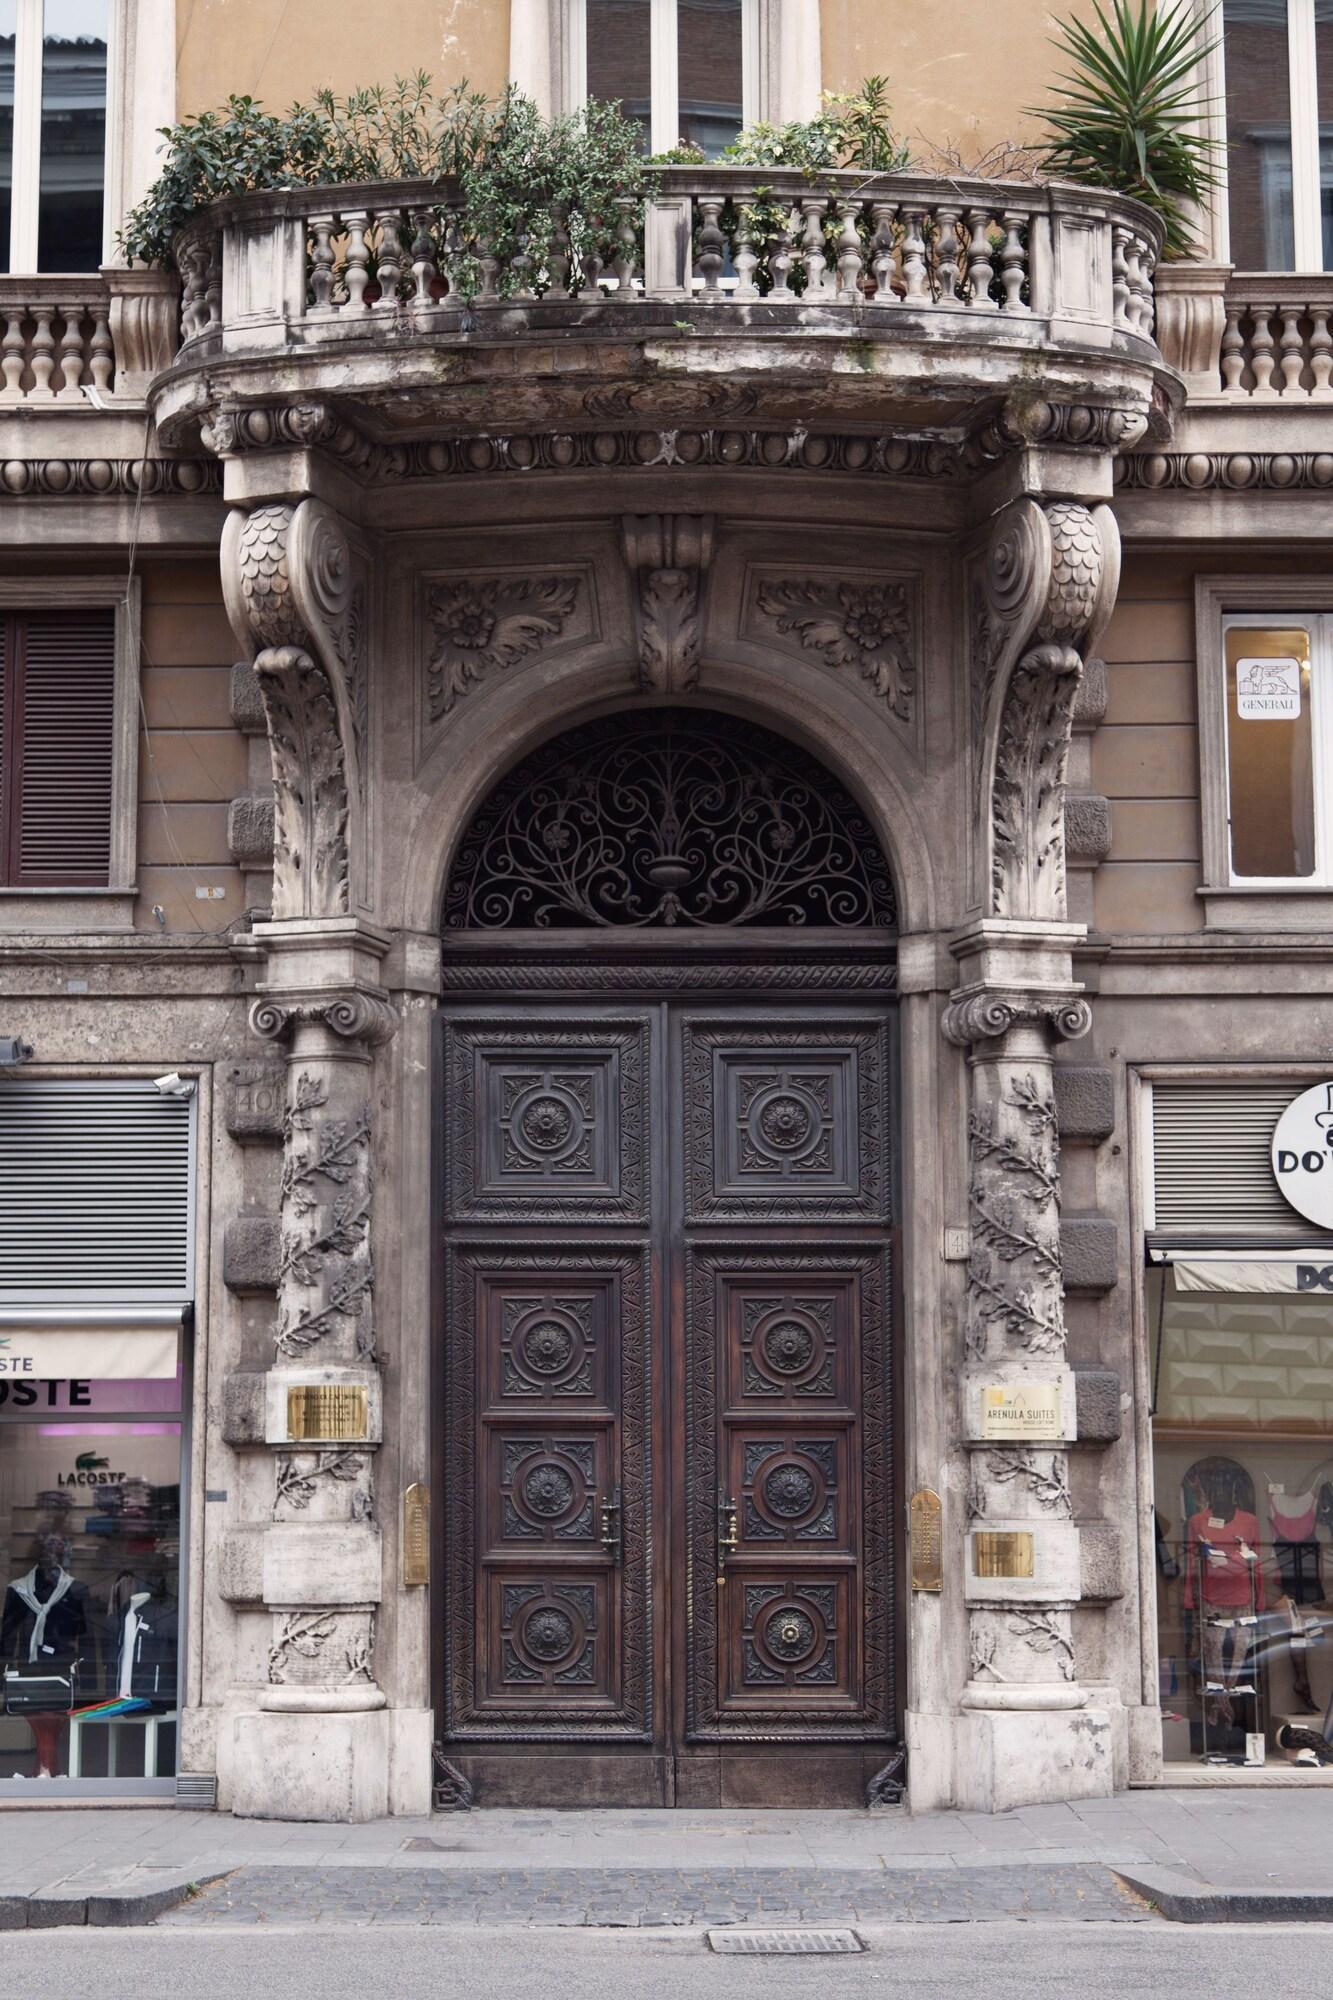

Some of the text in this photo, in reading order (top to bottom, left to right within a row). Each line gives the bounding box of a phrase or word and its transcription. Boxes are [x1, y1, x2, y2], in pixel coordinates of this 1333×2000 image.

[1242, 699, 1293, 709] GENERALI
[951, 1234, 964, 1253] 41
[987, 1409, 1056, 1419] ARENULA SUITES
